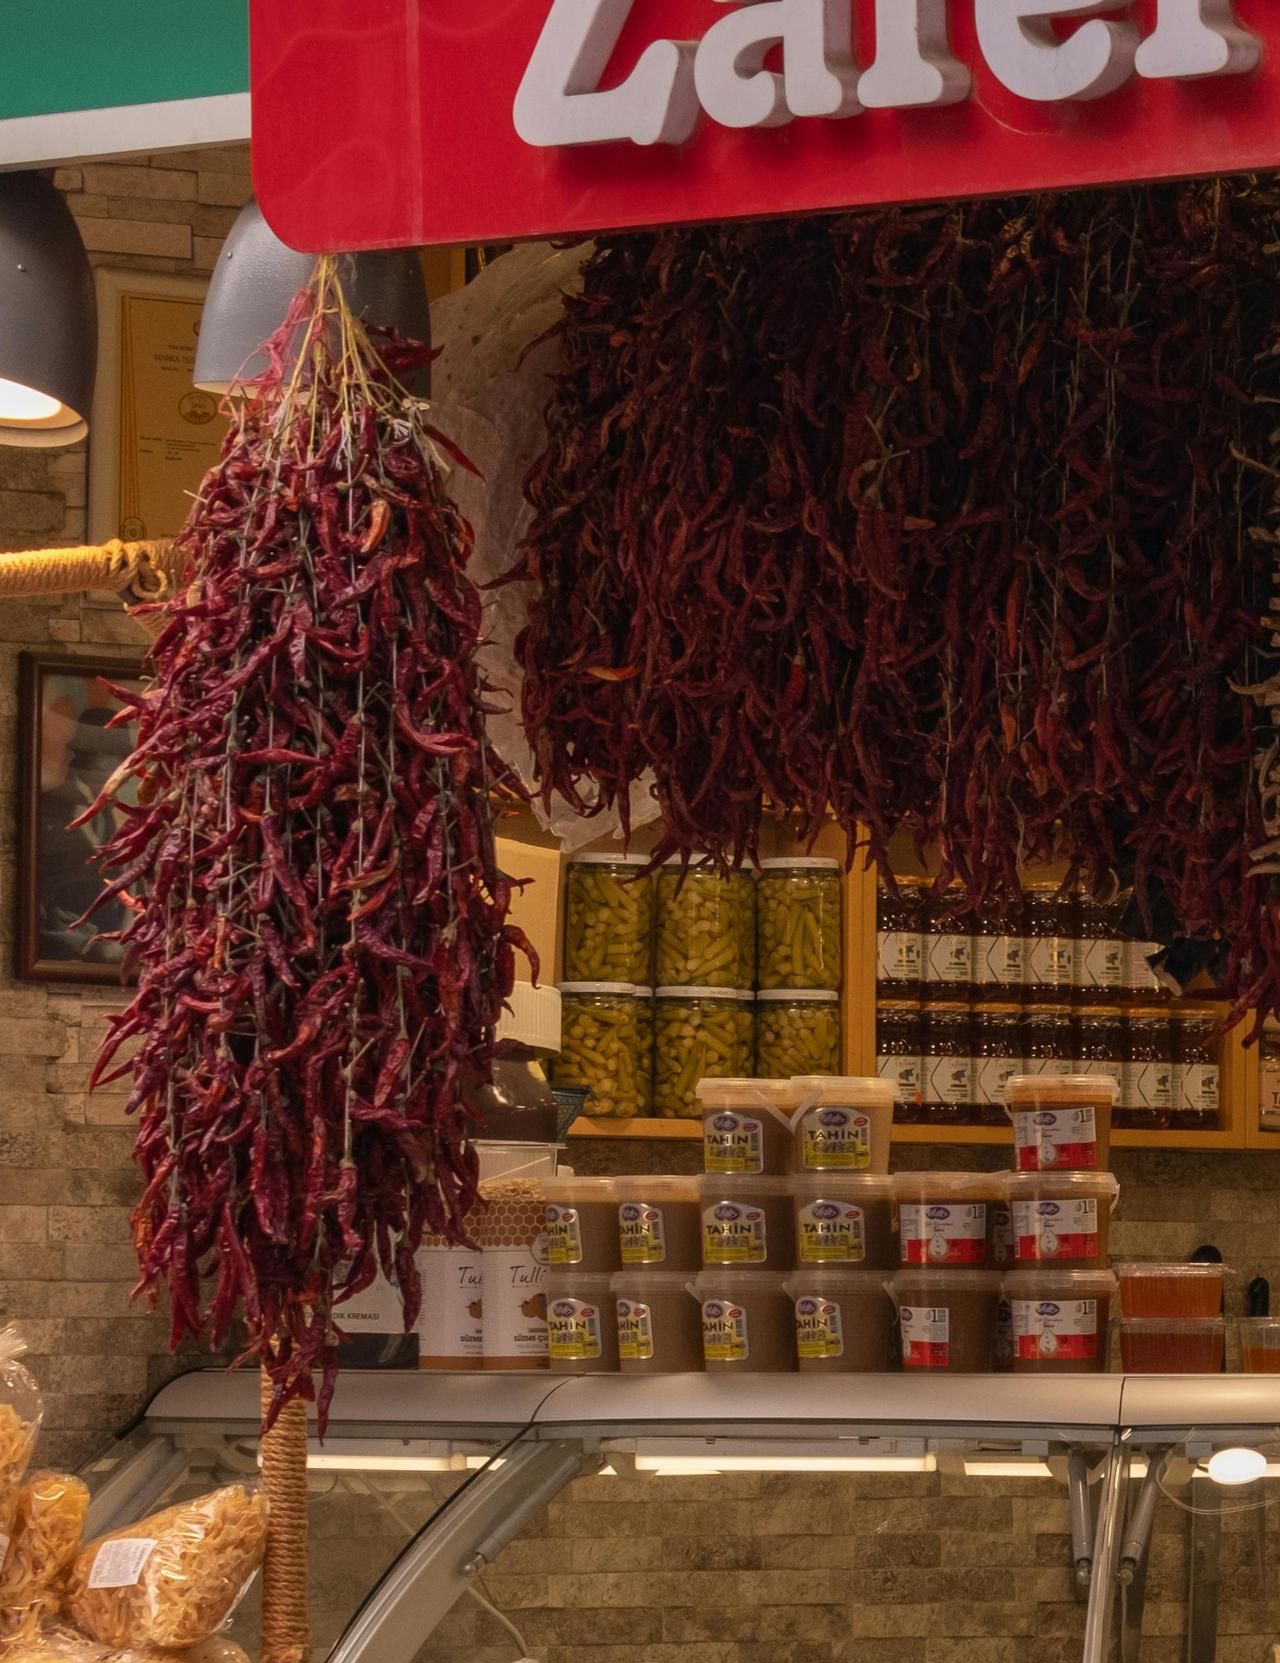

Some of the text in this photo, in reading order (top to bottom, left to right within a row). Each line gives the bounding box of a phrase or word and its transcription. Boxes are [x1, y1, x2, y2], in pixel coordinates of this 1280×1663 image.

[619, 1222, 649, 1235] AHİN
[706, 1222, 752, 1235] TAHİN
[803, 1221, 851, 1234] TAHİN
